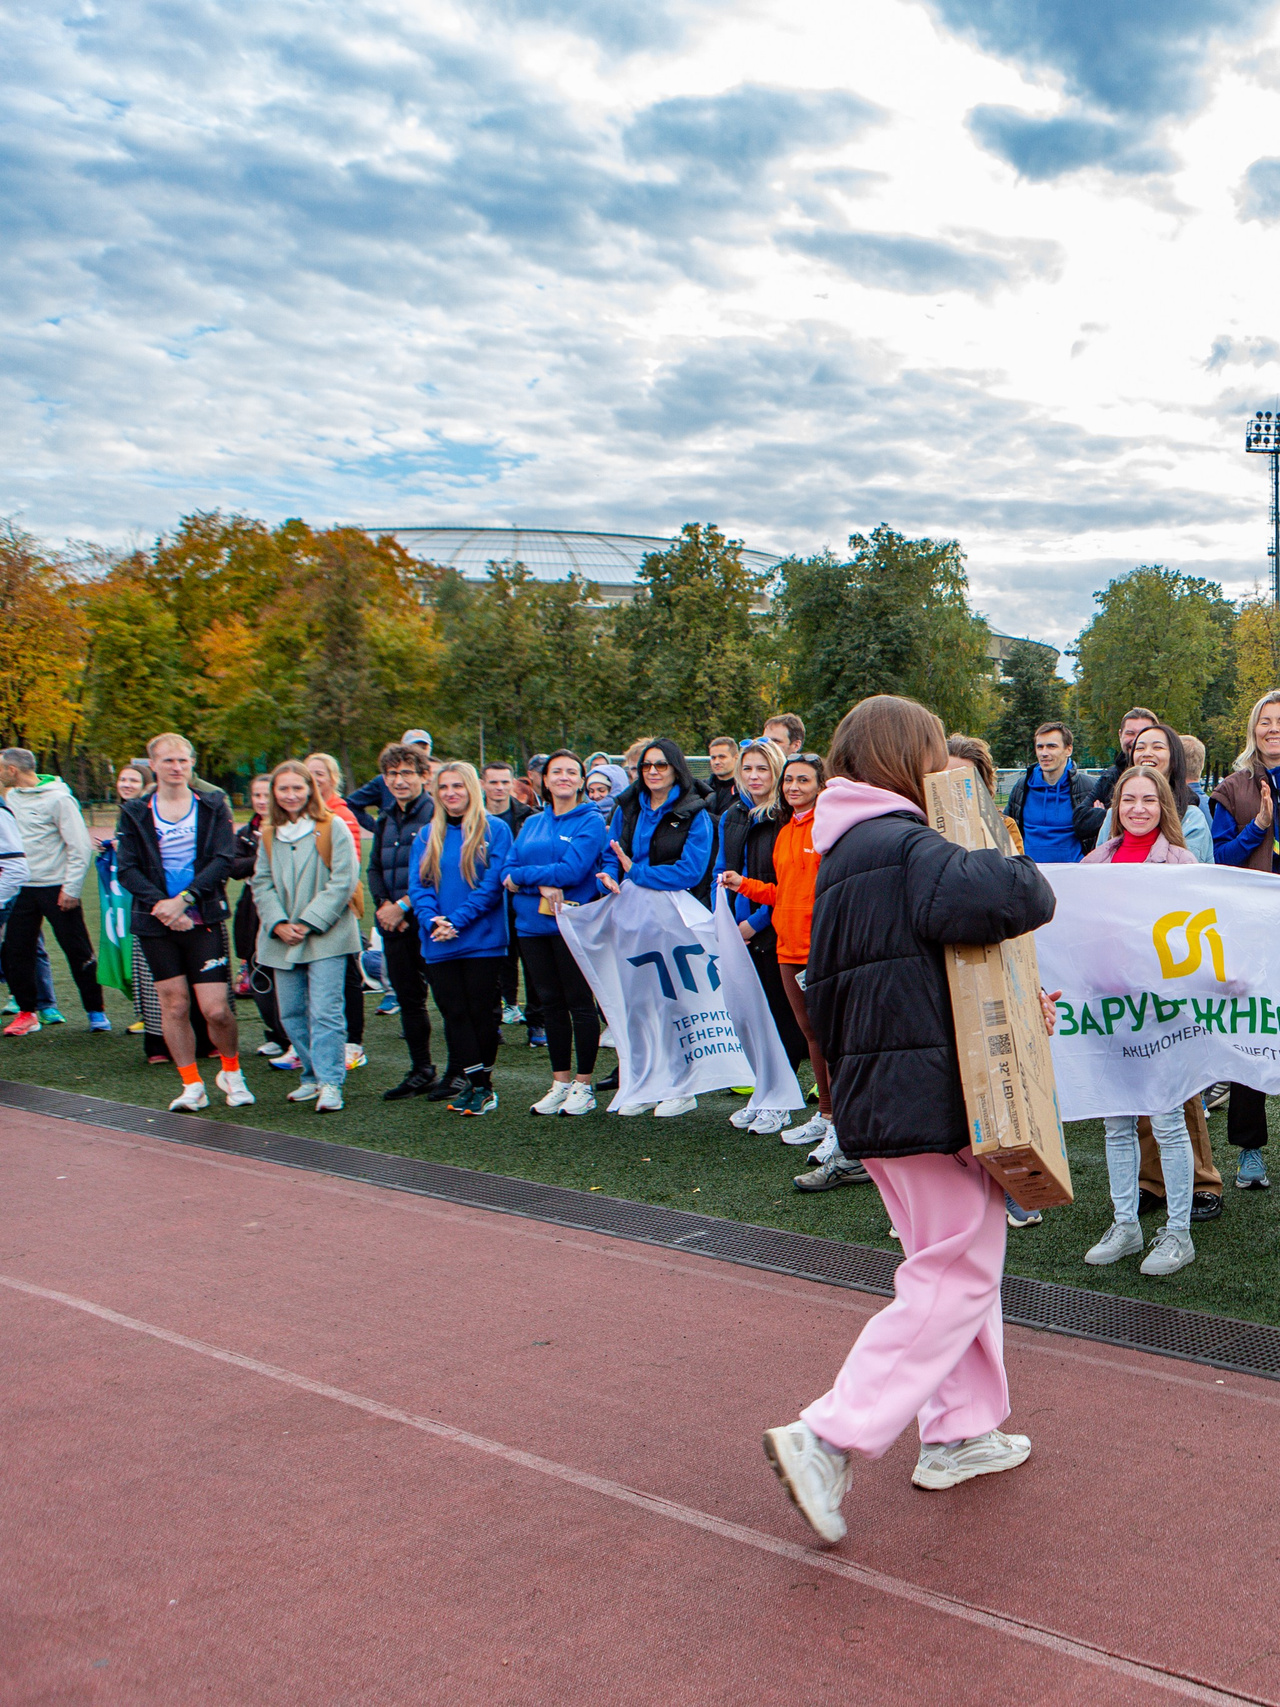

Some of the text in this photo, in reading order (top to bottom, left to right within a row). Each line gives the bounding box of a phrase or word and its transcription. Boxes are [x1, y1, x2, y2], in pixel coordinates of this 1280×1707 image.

[679, 1026, 738, 1048] ГЕНЕРИ
[1122, 1025, 1213, 1059] АКЦИОНЕРН
[684, 1042, 744, 1064] КОМПАН
[1002, 1079, 1014, 1100] LED
